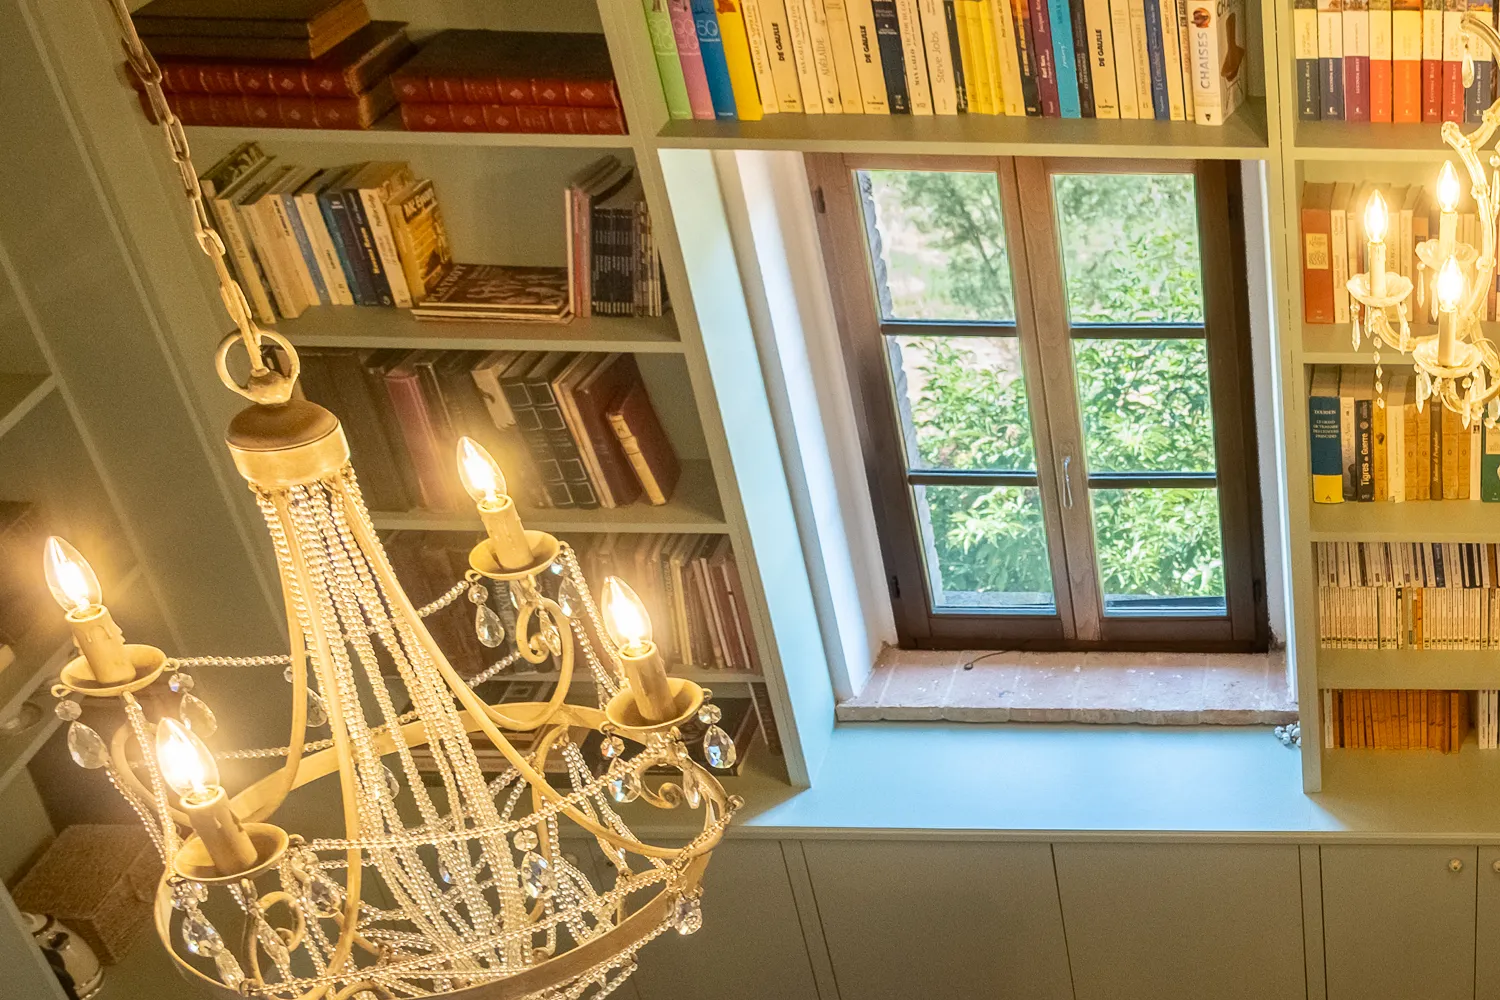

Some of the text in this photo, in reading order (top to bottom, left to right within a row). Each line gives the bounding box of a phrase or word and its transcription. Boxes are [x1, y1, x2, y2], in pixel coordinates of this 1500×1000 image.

[697, 20, 718, 37] 50
[772, 21, 785, 61] DE GAULLE
[860, 25, 872, 63] DE GAULLE
[1095, 28, 1105, 66] DE GAULLE
[930, 31, 945, 83] Steve Jobs
[1198, 32, 1211, 89] CHAISES
[1360, 432, 1368, 455] Guerre
[1360, 462, 1371, 486] Tigres
